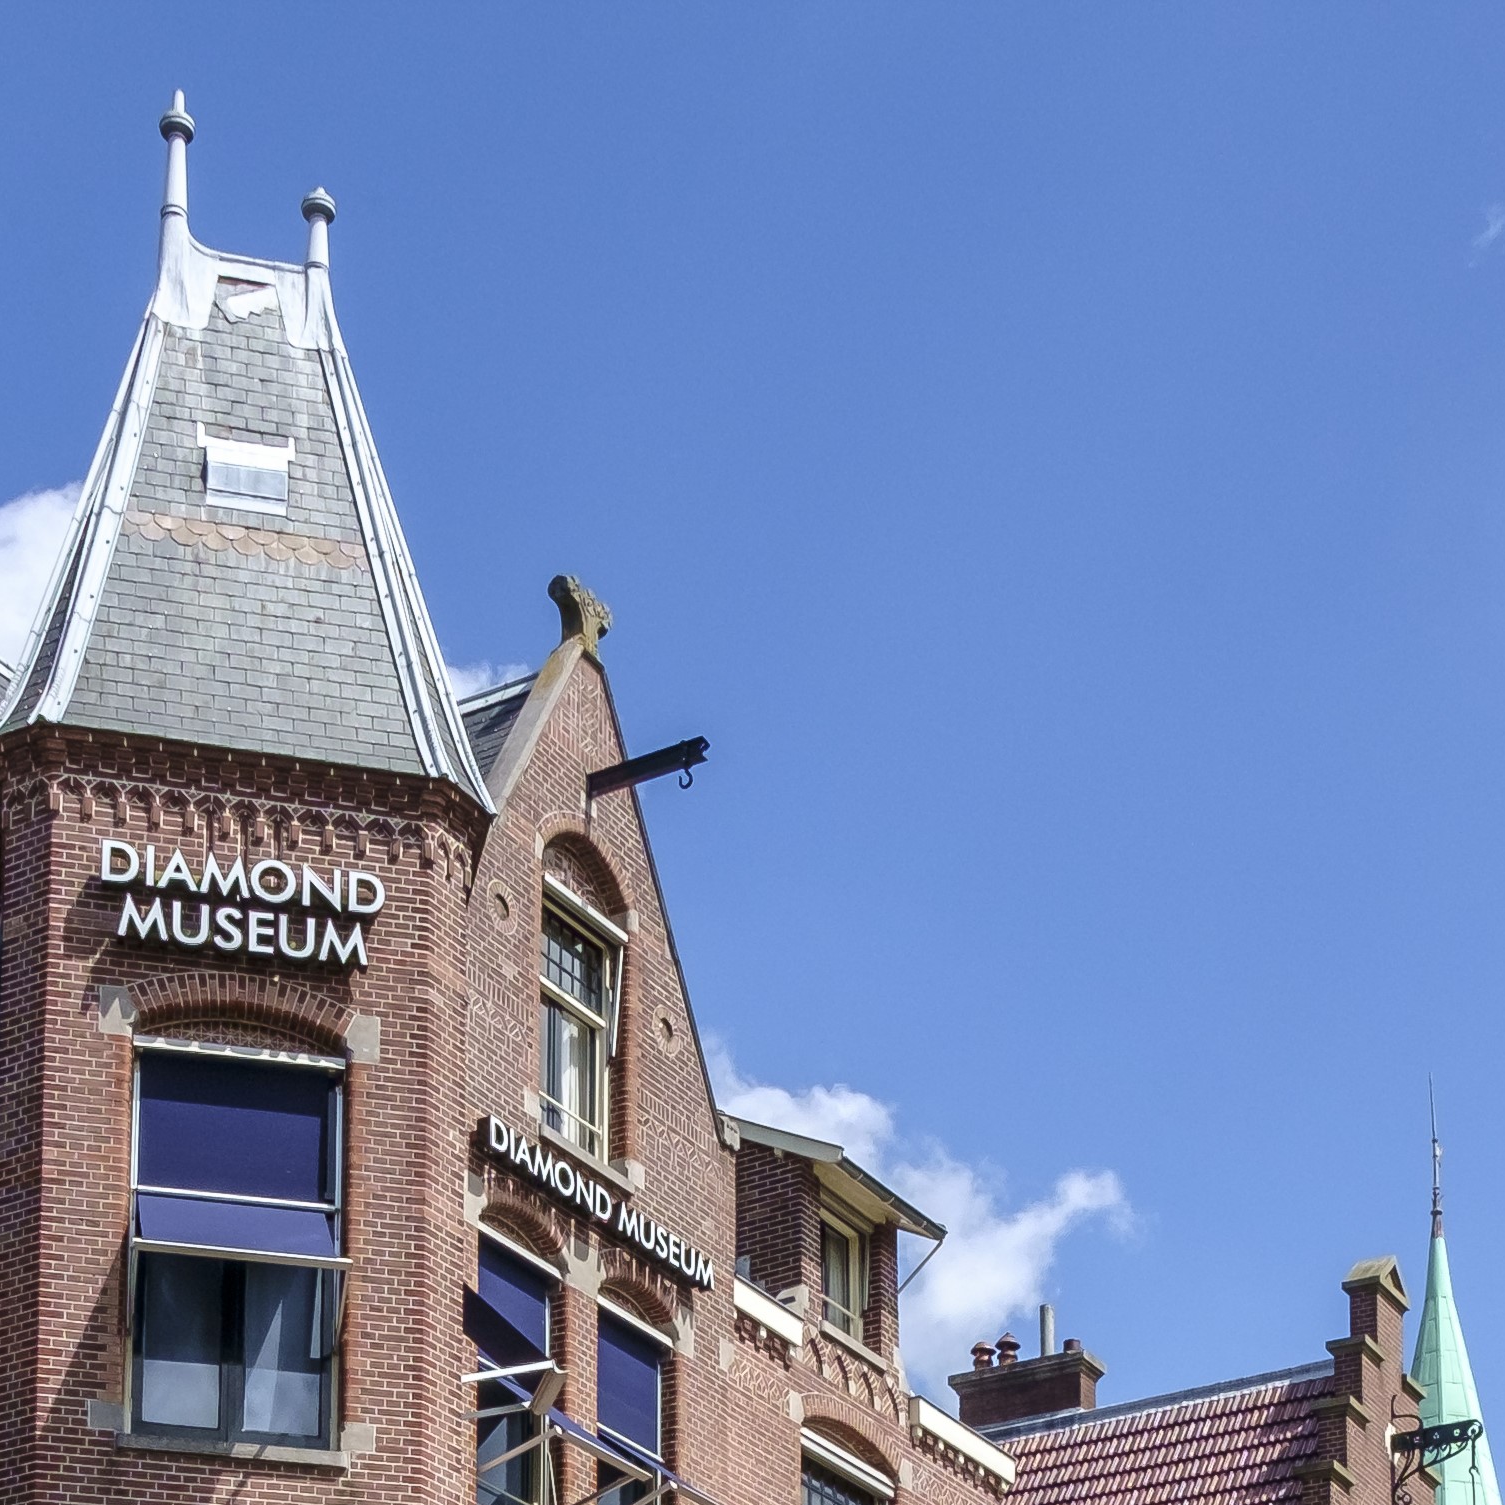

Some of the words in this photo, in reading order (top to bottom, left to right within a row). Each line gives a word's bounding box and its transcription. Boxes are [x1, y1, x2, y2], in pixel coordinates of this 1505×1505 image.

[100, 838, 387, 915] DIAMOND
[117, 892, 370, 967] MUSEUM
[489, 1114, 613, 1223] DIAMOND
[618, 1201, 716, 1291] MUSEUM
